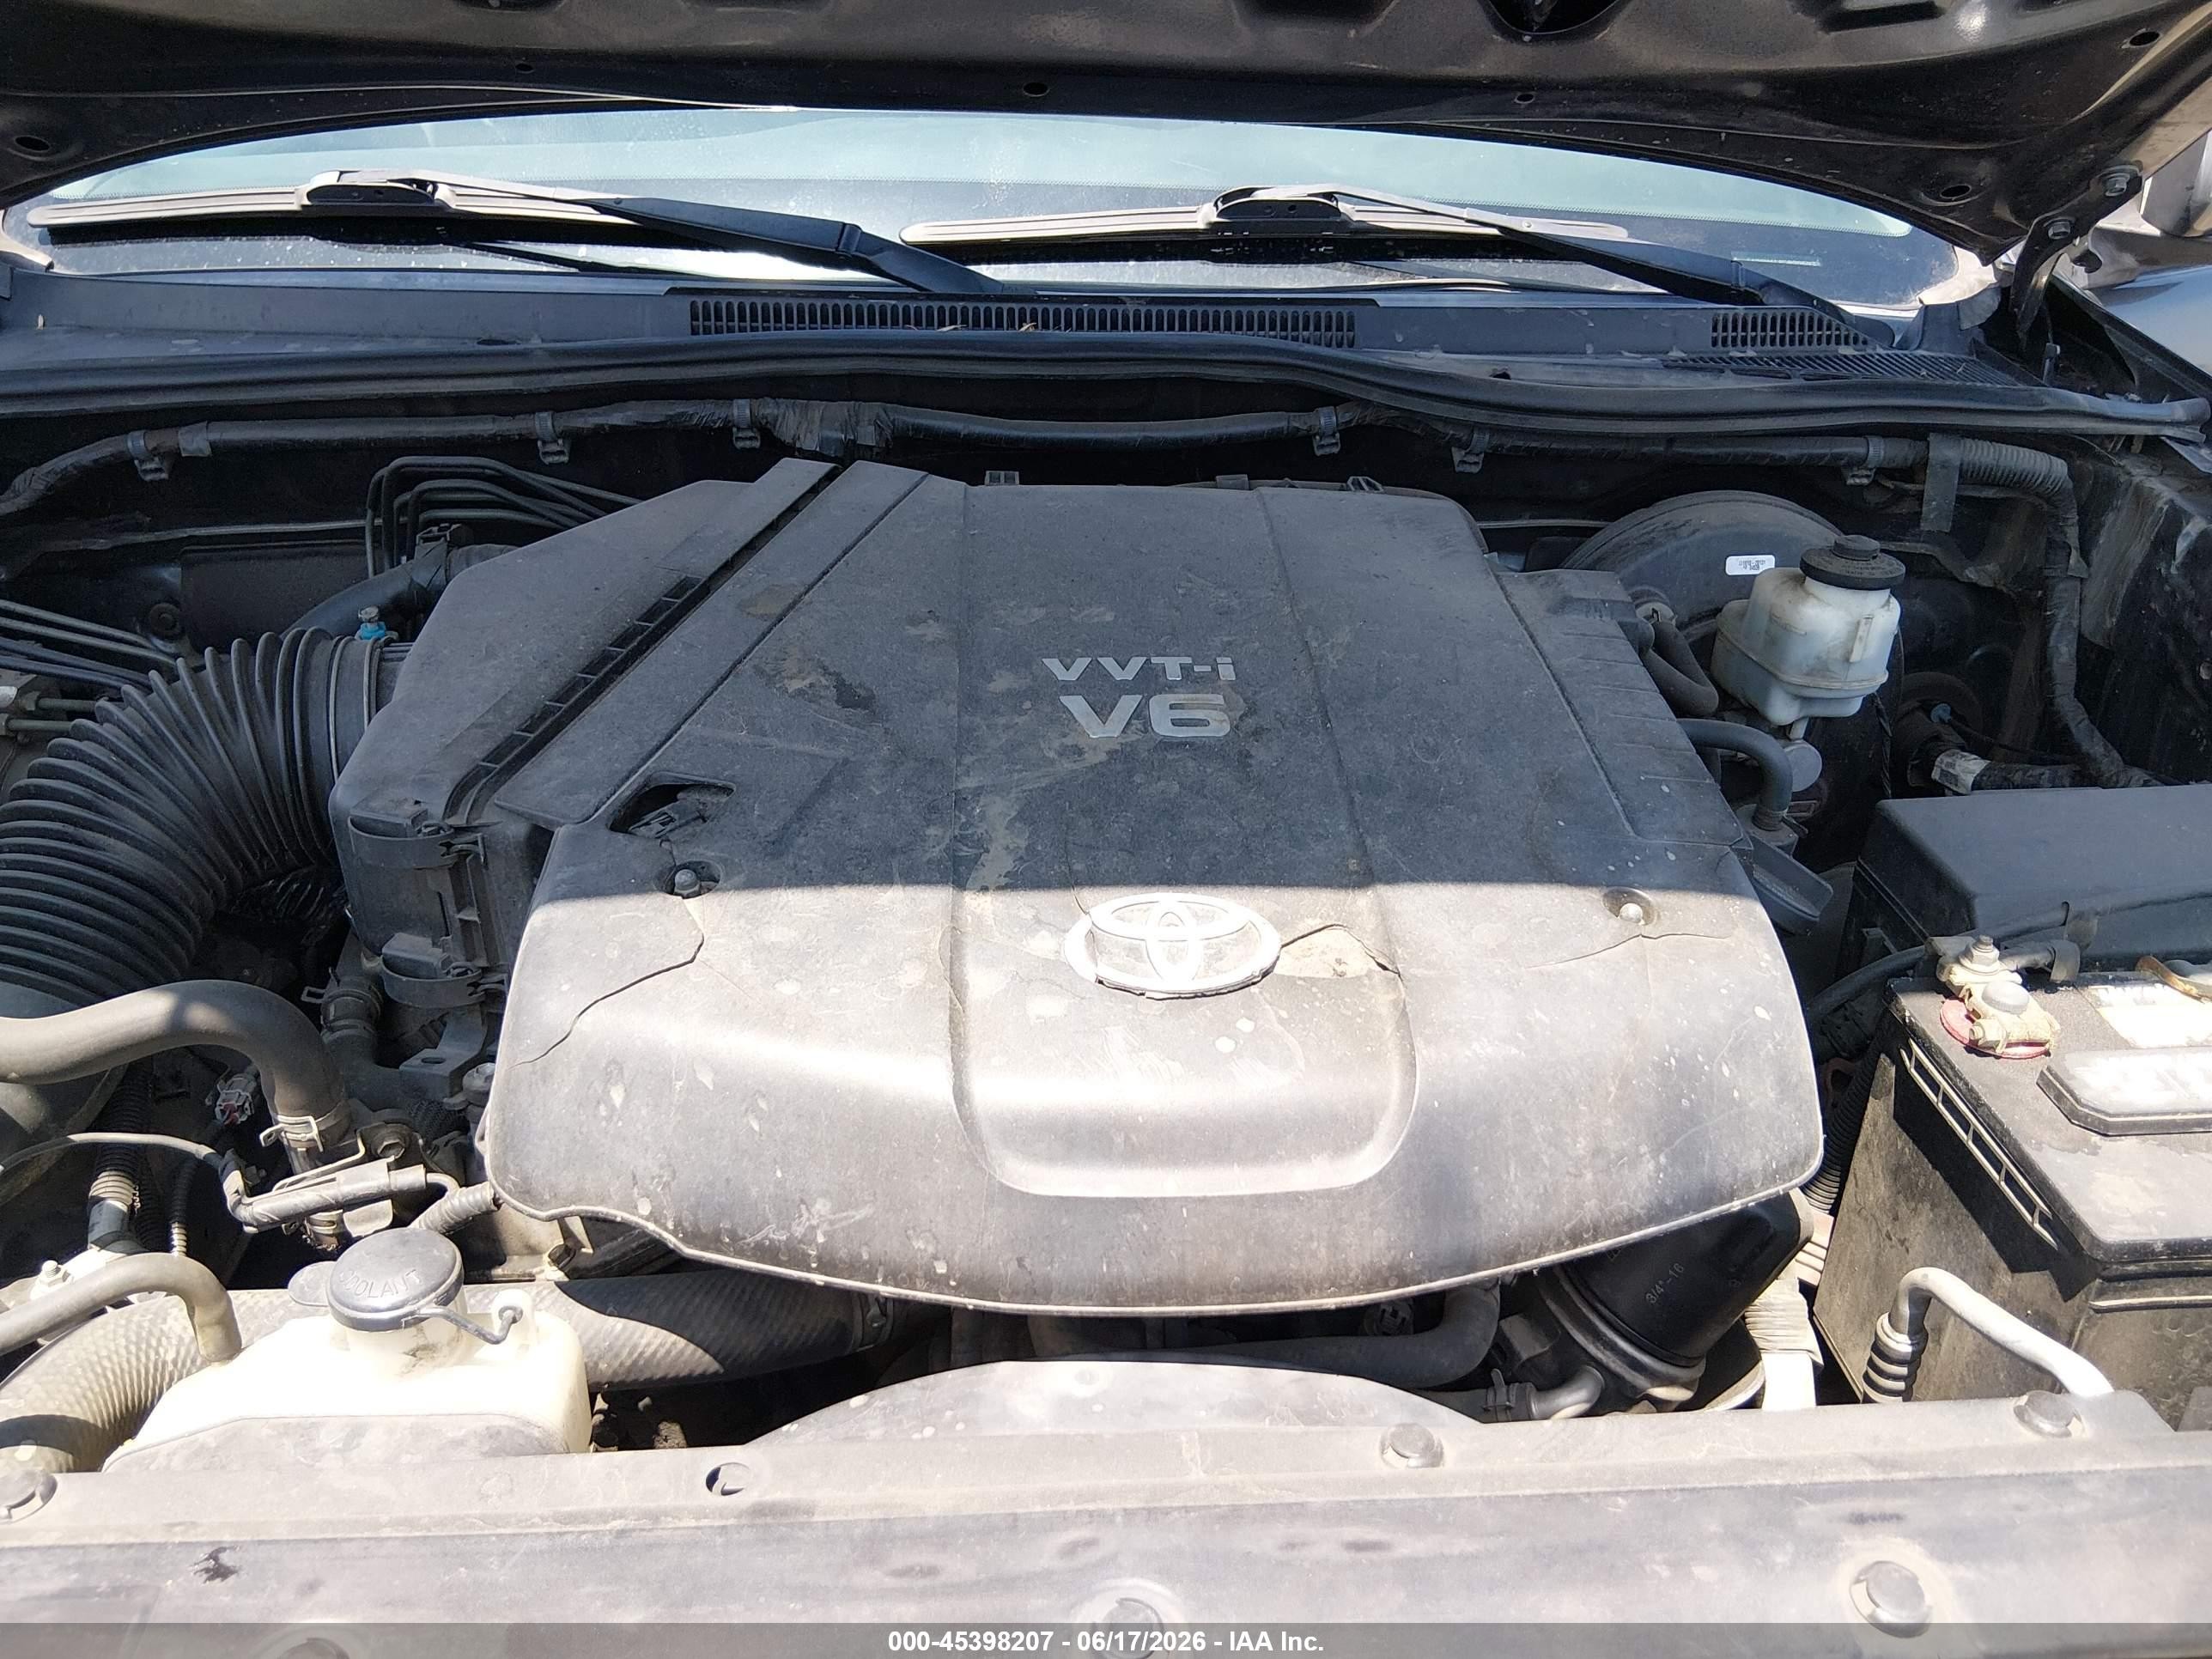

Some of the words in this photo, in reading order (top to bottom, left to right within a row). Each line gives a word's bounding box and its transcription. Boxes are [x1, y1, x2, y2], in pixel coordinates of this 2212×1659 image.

[1042, 656, 1237, 681] VVT-i
[1059, 693, 1231, 738] V6
[338, 1269, 422, 1298] COOLANT
